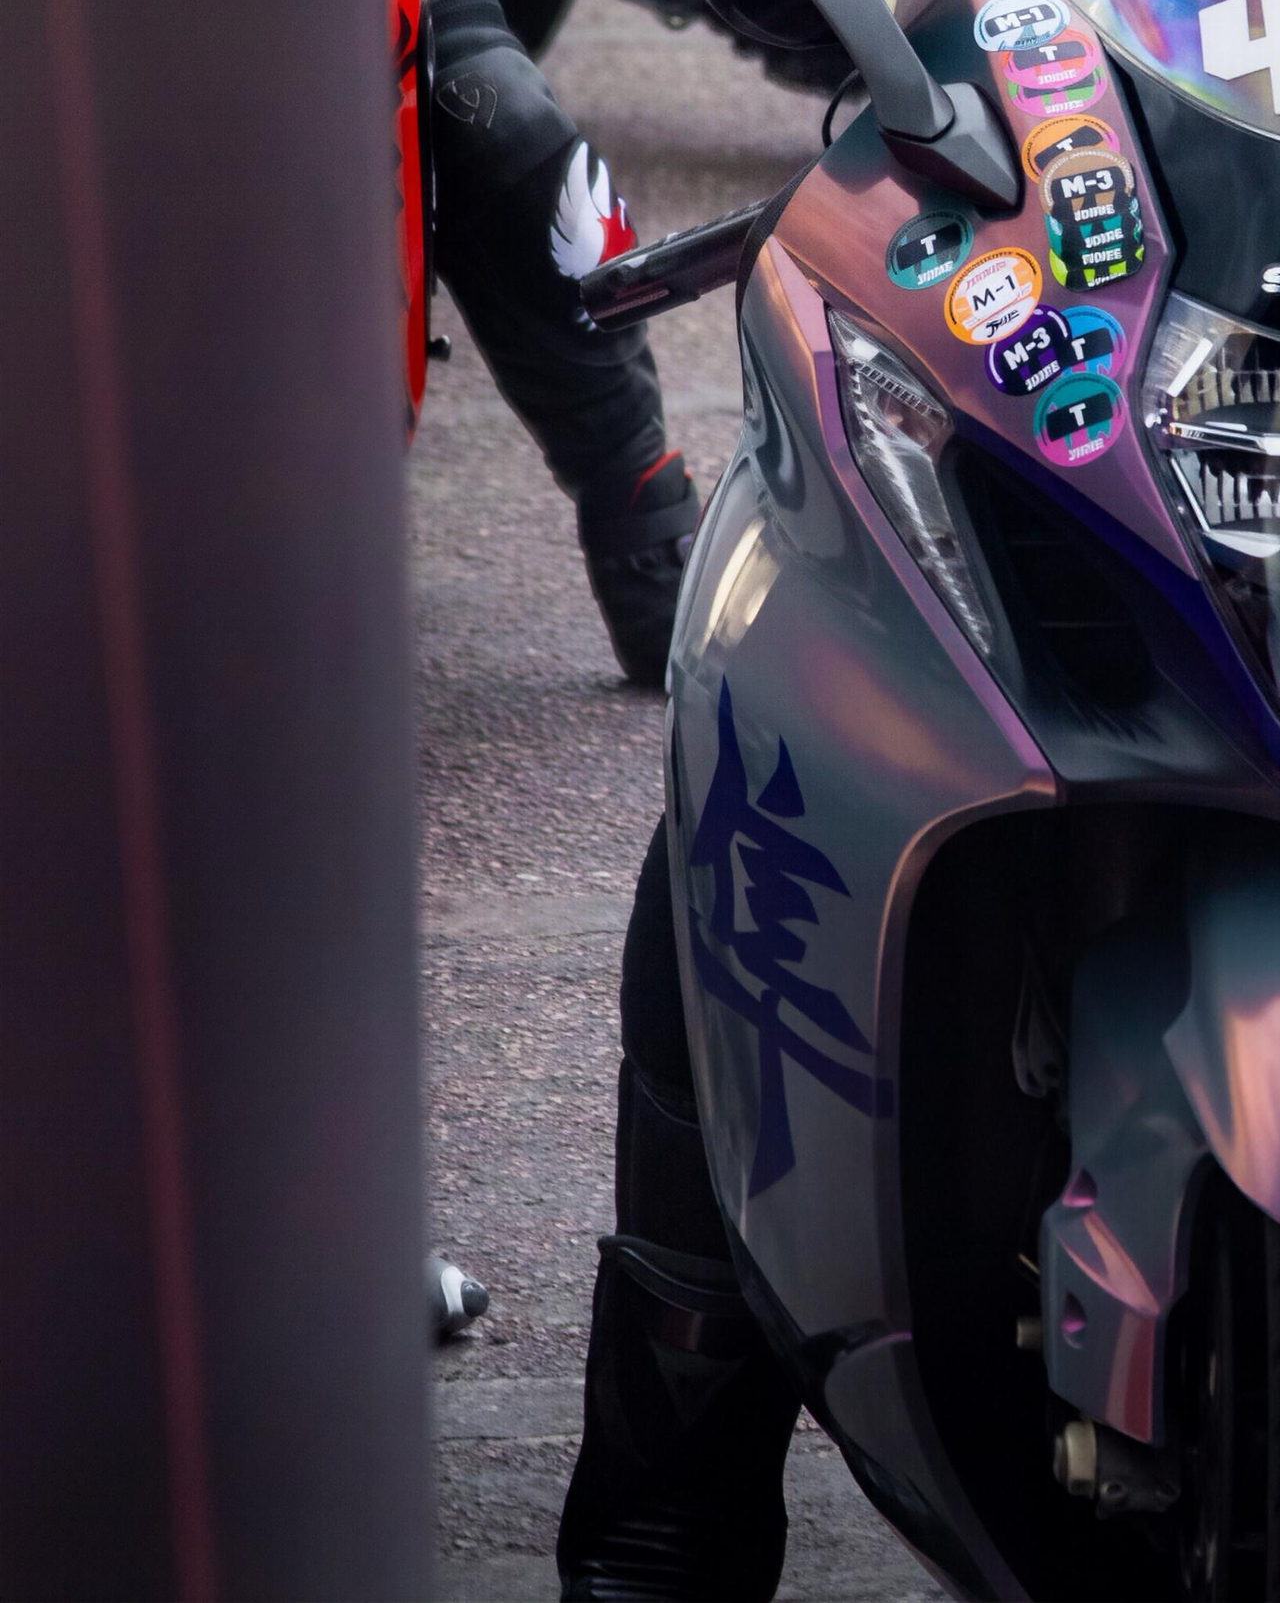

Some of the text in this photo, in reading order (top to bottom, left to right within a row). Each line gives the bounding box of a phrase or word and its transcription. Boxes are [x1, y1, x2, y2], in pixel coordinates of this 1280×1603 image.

[994, 6, 1044, 31] M-1
[1039, 45, 1058, 61] T
[1060, 169, 1114, 198] M-3
[920, 234, 936, 255] T
[972, 274, 1016, 311] M-1
[1003, 327, 1051, 370] M-3
[1069, 403, 1086, 427] T
